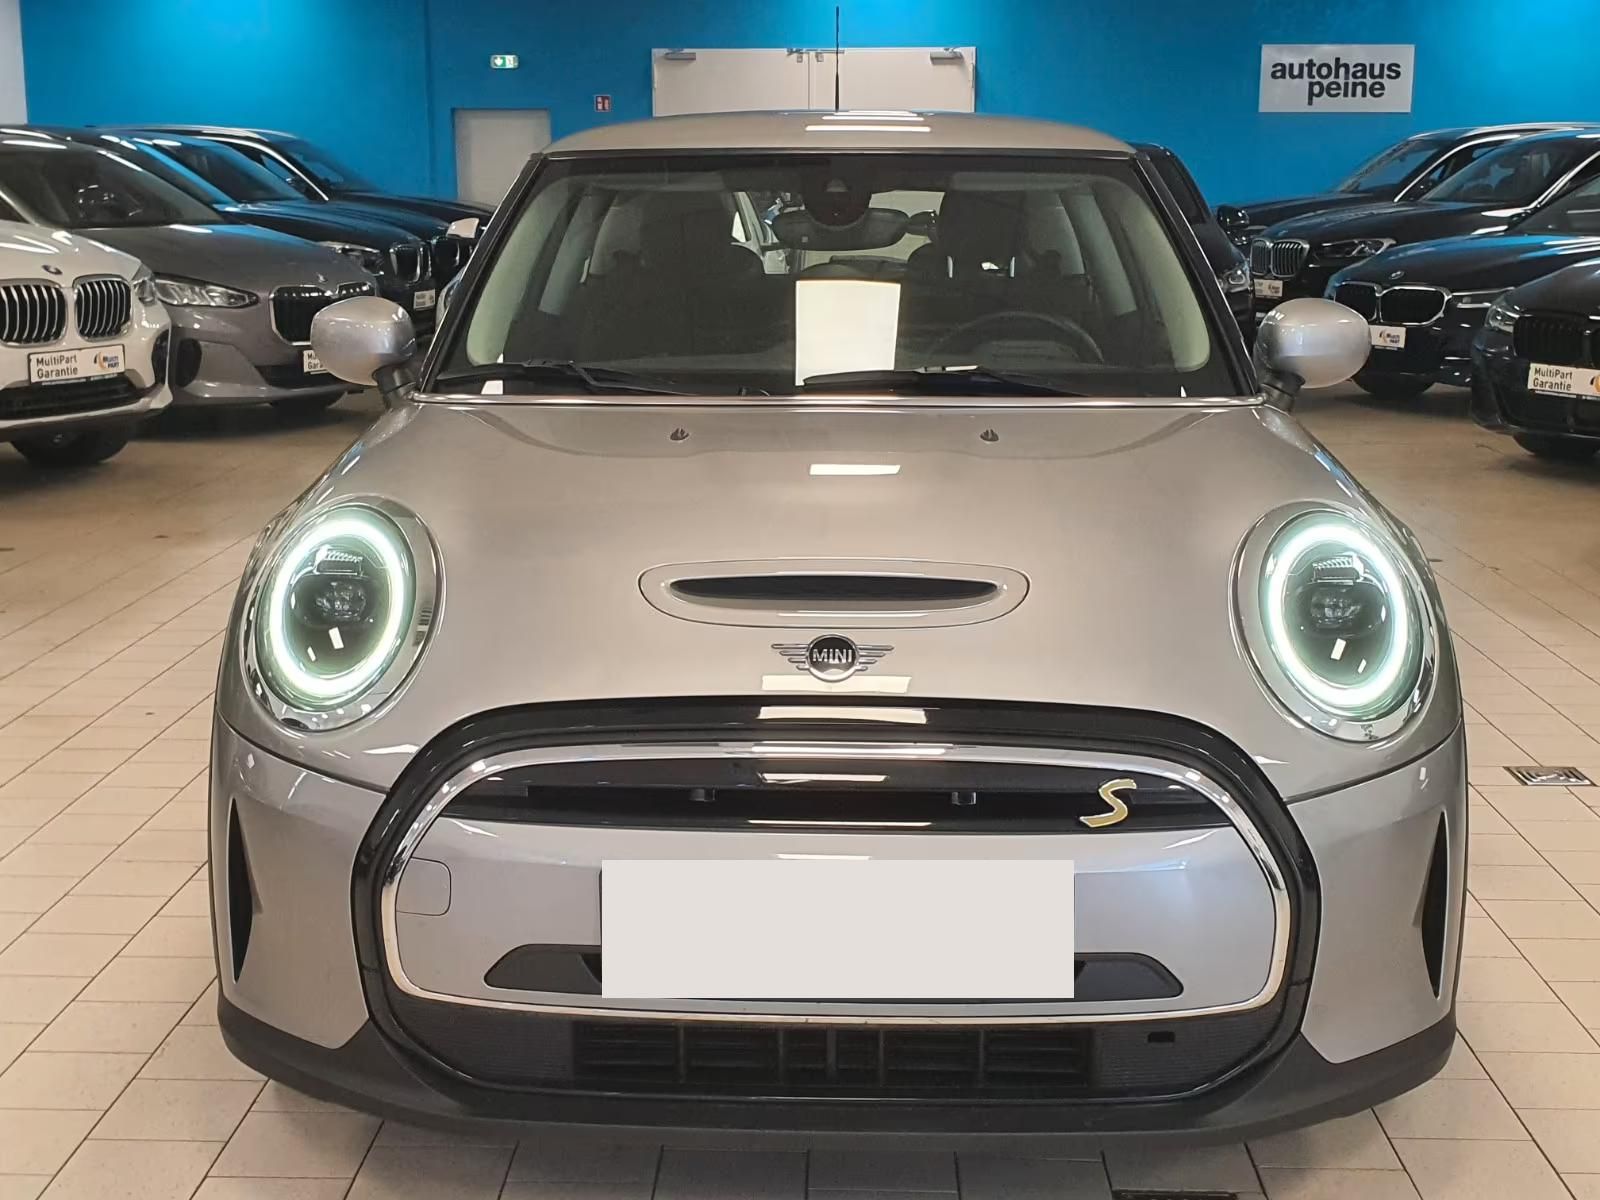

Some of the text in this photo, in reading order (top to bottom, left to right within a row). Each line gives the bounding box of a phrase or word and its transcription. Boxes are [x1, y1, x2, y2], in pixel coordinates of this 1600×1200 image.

[1271, 57, 1402, 80] autohaus
[1307, 80, 1386, 106] peine
[36, 354, 77, 367] MultiPart
[37, 366, 78, 379] Garantie
[1534, 367, 1573, 380] MultiPart
[1533, 377, 1572, 391] Garantie
[812, 648, 853, 664] MINI
[1079, 778, 1137, 828] S
